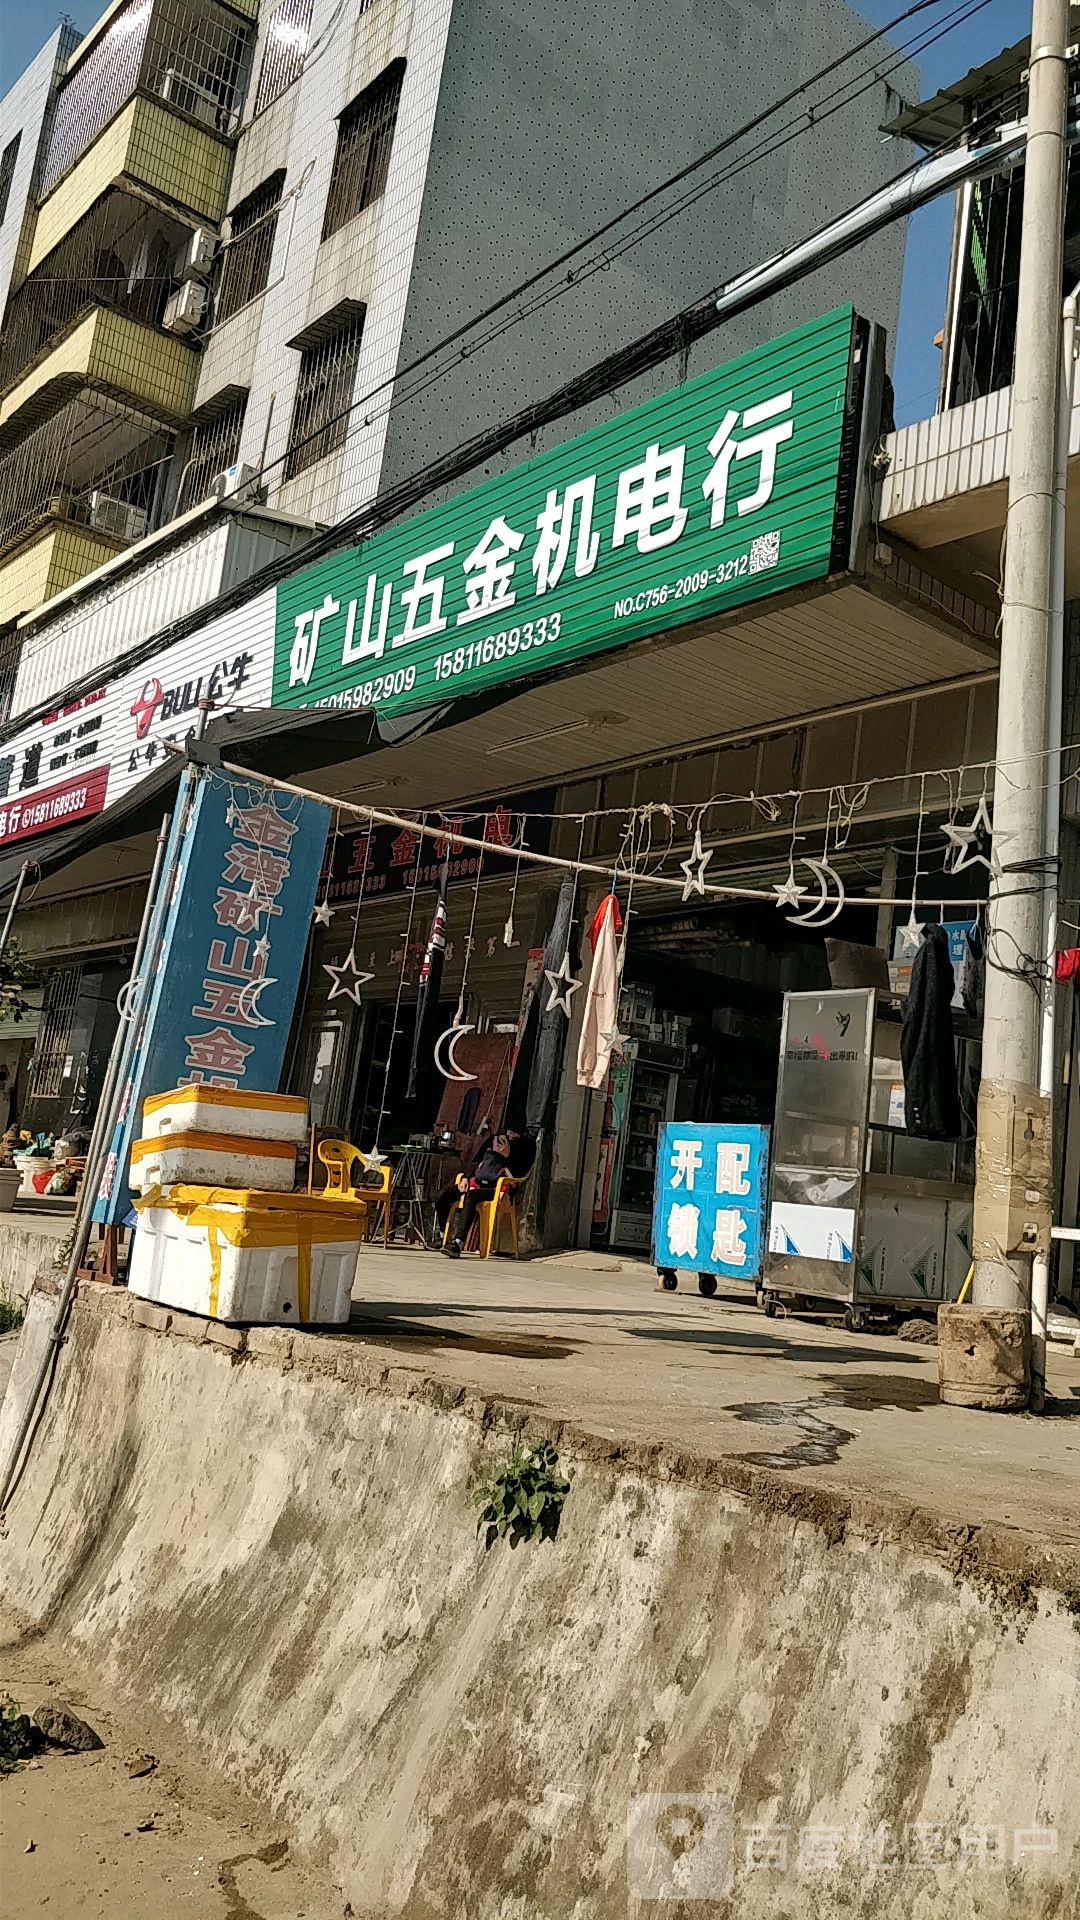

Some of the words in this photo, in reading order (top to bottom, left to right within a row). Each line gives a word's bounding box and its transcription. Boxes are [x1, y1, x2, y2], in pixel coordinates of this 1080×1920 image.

[289, 390, 794, 687] 矿山五金机电行
[614, 555, 748, 619] NO.C756-2009-3212
[434, 612, 561, 681] 15811689333
